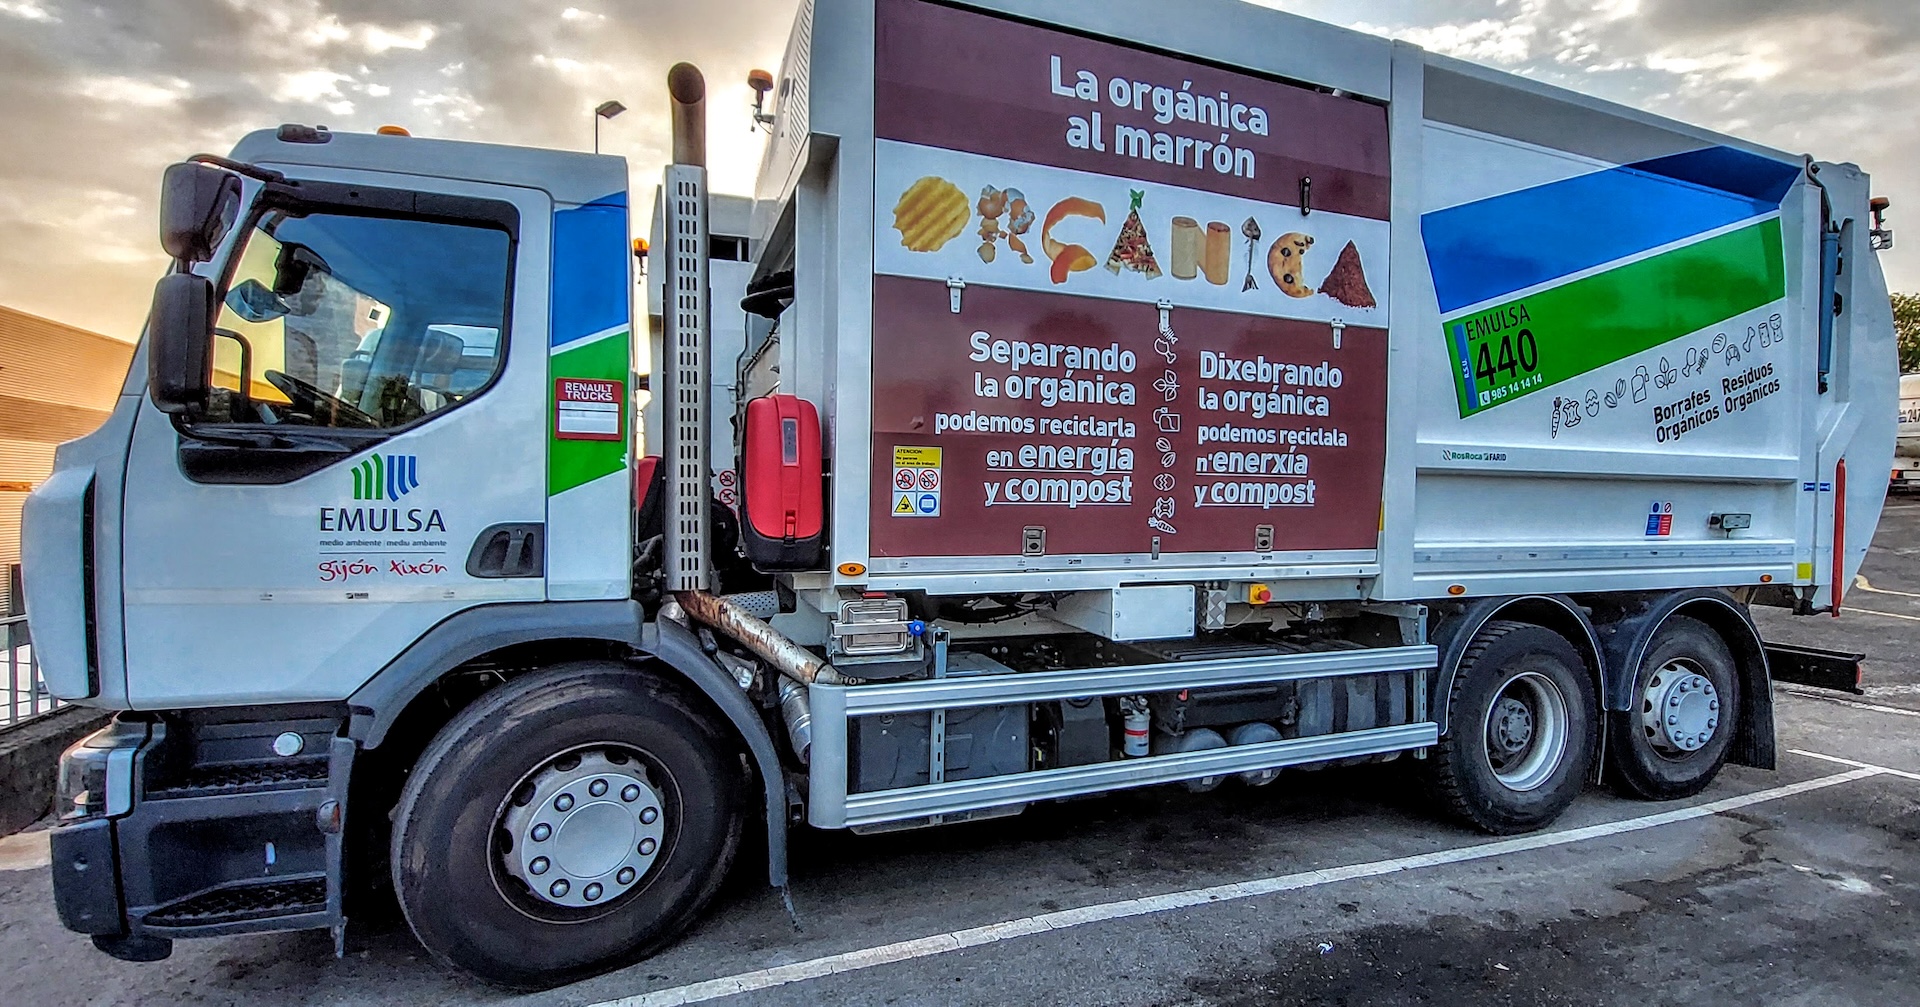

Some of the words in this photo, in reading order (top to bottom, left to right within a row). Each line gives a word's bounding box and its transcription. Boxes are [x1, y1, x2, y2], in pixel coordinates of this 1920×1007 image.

[1050, 55, 1099, 102] La
[1108, 77, 1270, 136] orgánica
[1066, 111, 1105, 152] al
[1115, 124, 1255, 179] marrón
[1465, 303, 1532, 342] EMULSA
[968, 331, 1137, 374] Separando
[1199, 350, 1343, 389] Dixebrando
[1475, 328, 1539, 386] 440
[564, 382, 613, 393] RENAULT
[564, 390, 613, 401] TRUCKS
[974, 371, 999, 398] la
[1004, 369, 1136, 407] orgánica
[1491, 386, 1508, 401] 985
[1509, 381, 1520, 394] 14
[1520, 377, 1531, 390] 14
[1532, 372, 1543, 385] 14
[1721, 362, 1774, 396] Residuos
[1724, 378, 1781, 414] Orgánicos
[1198, 386, 1219, 410] la
[1222, 384, 1330, 419] orgánica
[1653, 389, 1711, 425] Borrafes
[934, 410, 1036, 435] podemos
[1039, 414, 1136, 438] reciclarla
[1197, 423, 1277, 445] podemos
[1279, 427, 1348, 447] reciclala
[1656, 405, 1720, 443] Orgánicos
[986, 450, 1014, 468] en
[1018, 438, 1135, 476] energía
[1451, 451, 1483, 461] RosRoca
[1489, 452, 1507, 462] FARID
[984, 481, 1000, 507] y
[1004, 475, 1133, 508] compost
[1193, 485, 1208, 508] y
[1210, 479, 1316, 509] compost
[320, 507, 447, 532] EMULSA
